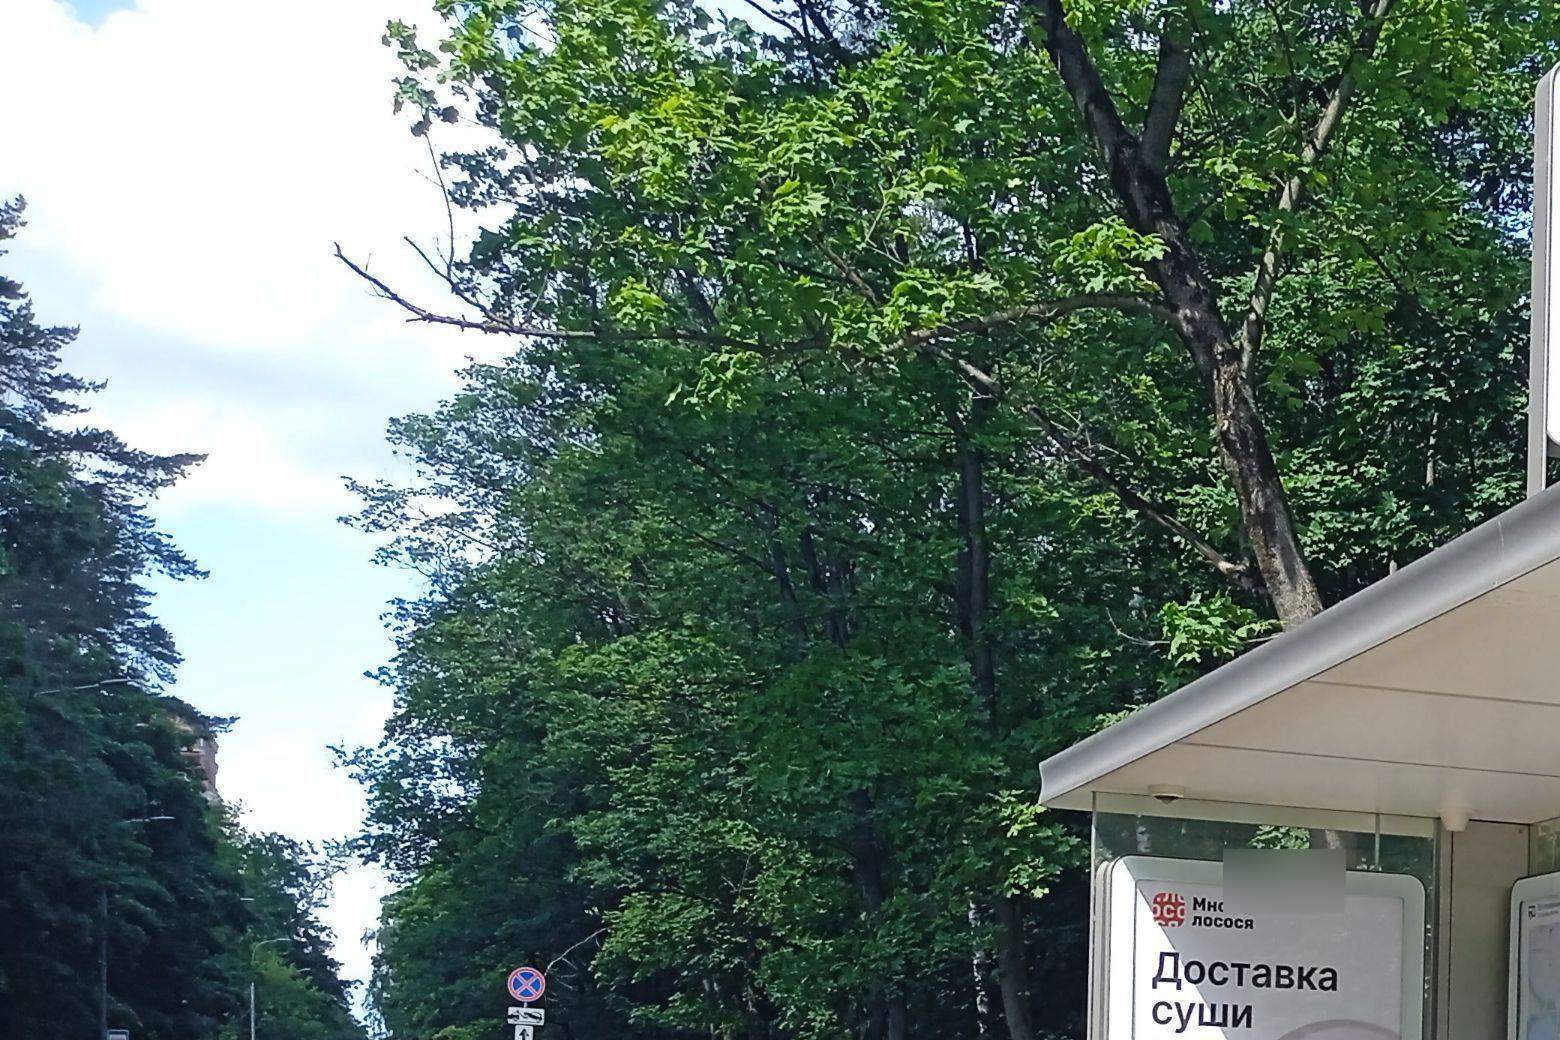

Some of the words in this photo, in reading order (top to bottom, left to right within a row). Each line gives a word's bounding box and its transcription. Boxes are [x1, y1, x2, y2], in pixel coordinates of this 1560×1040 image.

[1191, 914, 1254, 930] лосося
[1151, 952, 1339, 993] Доставка
[1151, 1000, 1253, 1035] суши
